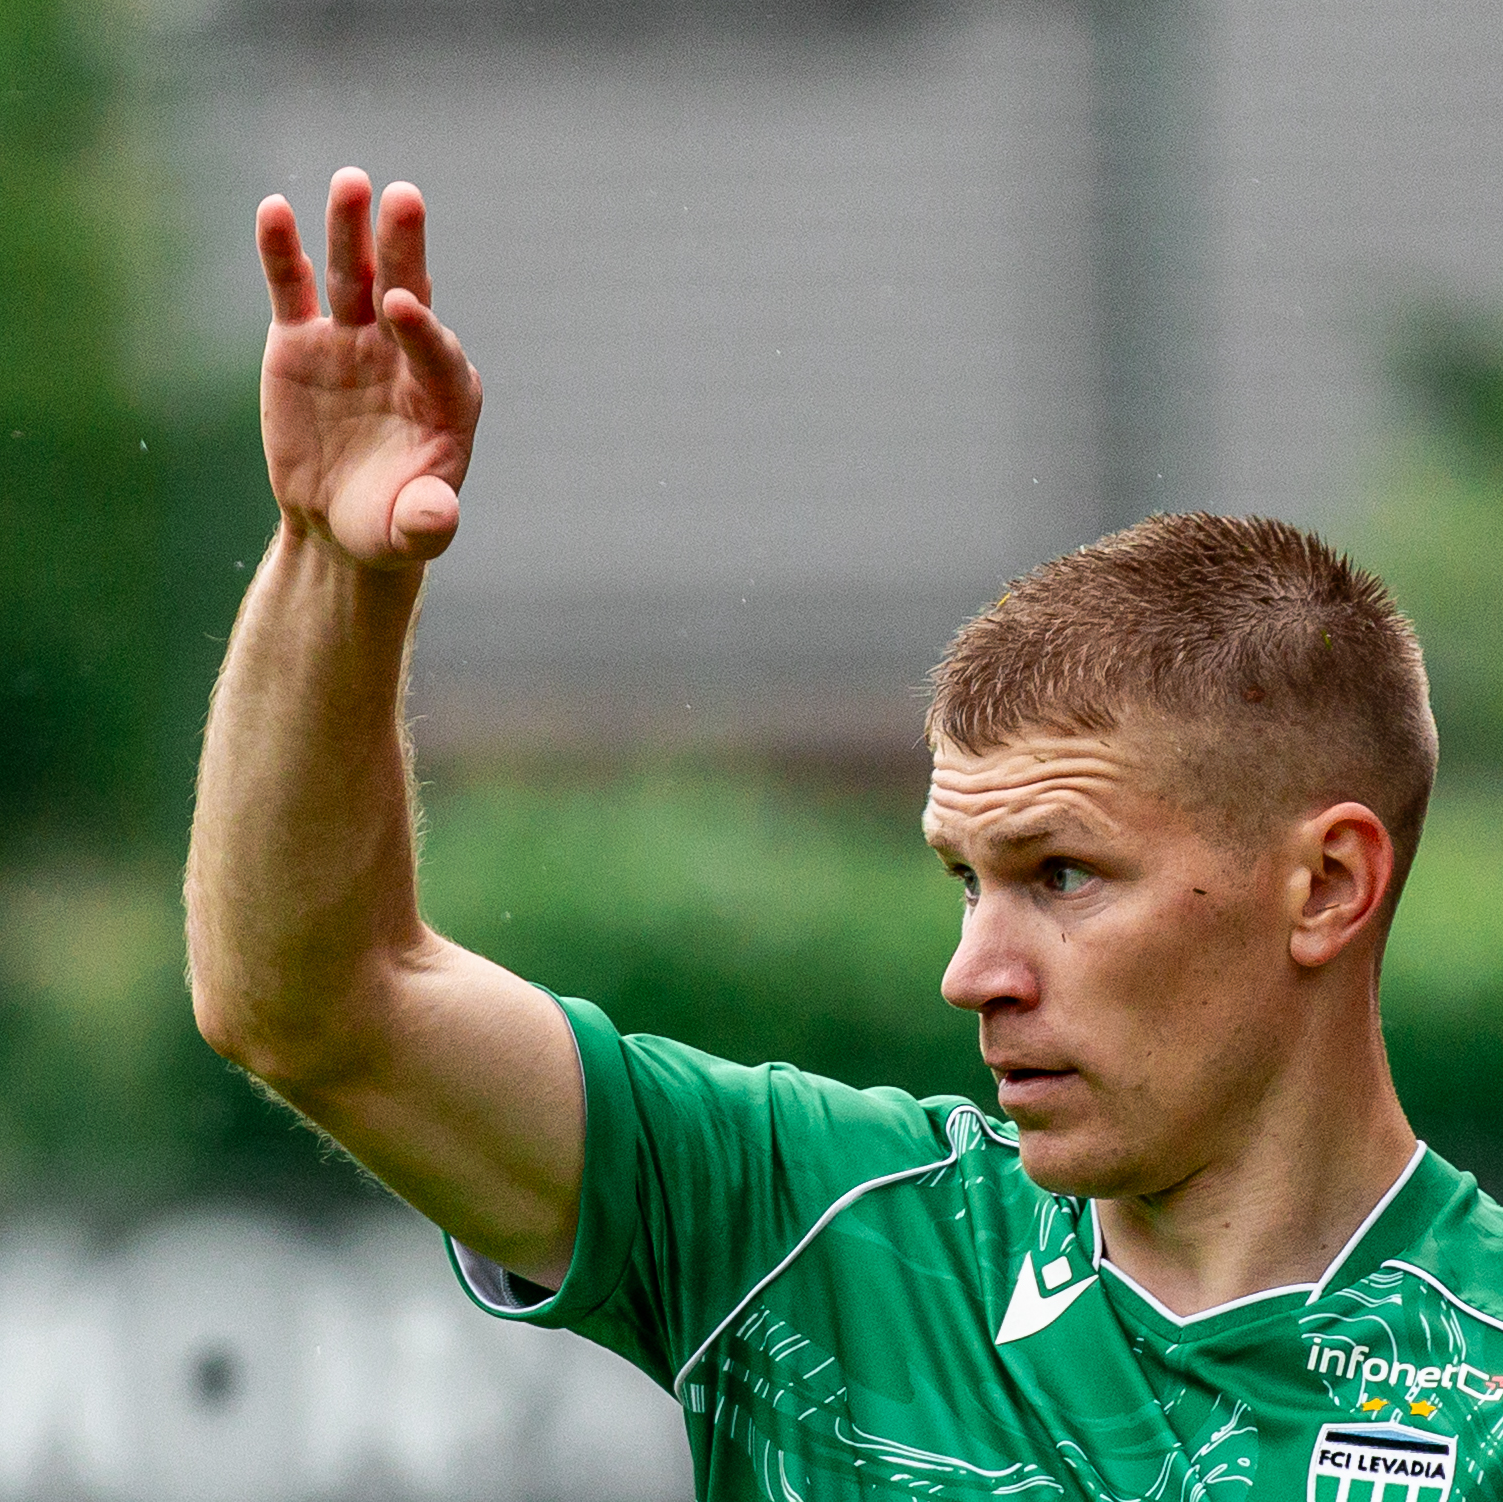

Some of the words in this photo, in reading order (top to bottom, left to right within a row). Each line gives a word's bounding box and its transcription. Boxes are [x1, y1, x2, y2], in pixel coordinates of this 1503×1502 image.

[1307, 1337, 1461, 1389] infonet
[1318, 1450, 1352, 1469] FCI
[1357, 1454, 1446, 1480] LEVADIA
